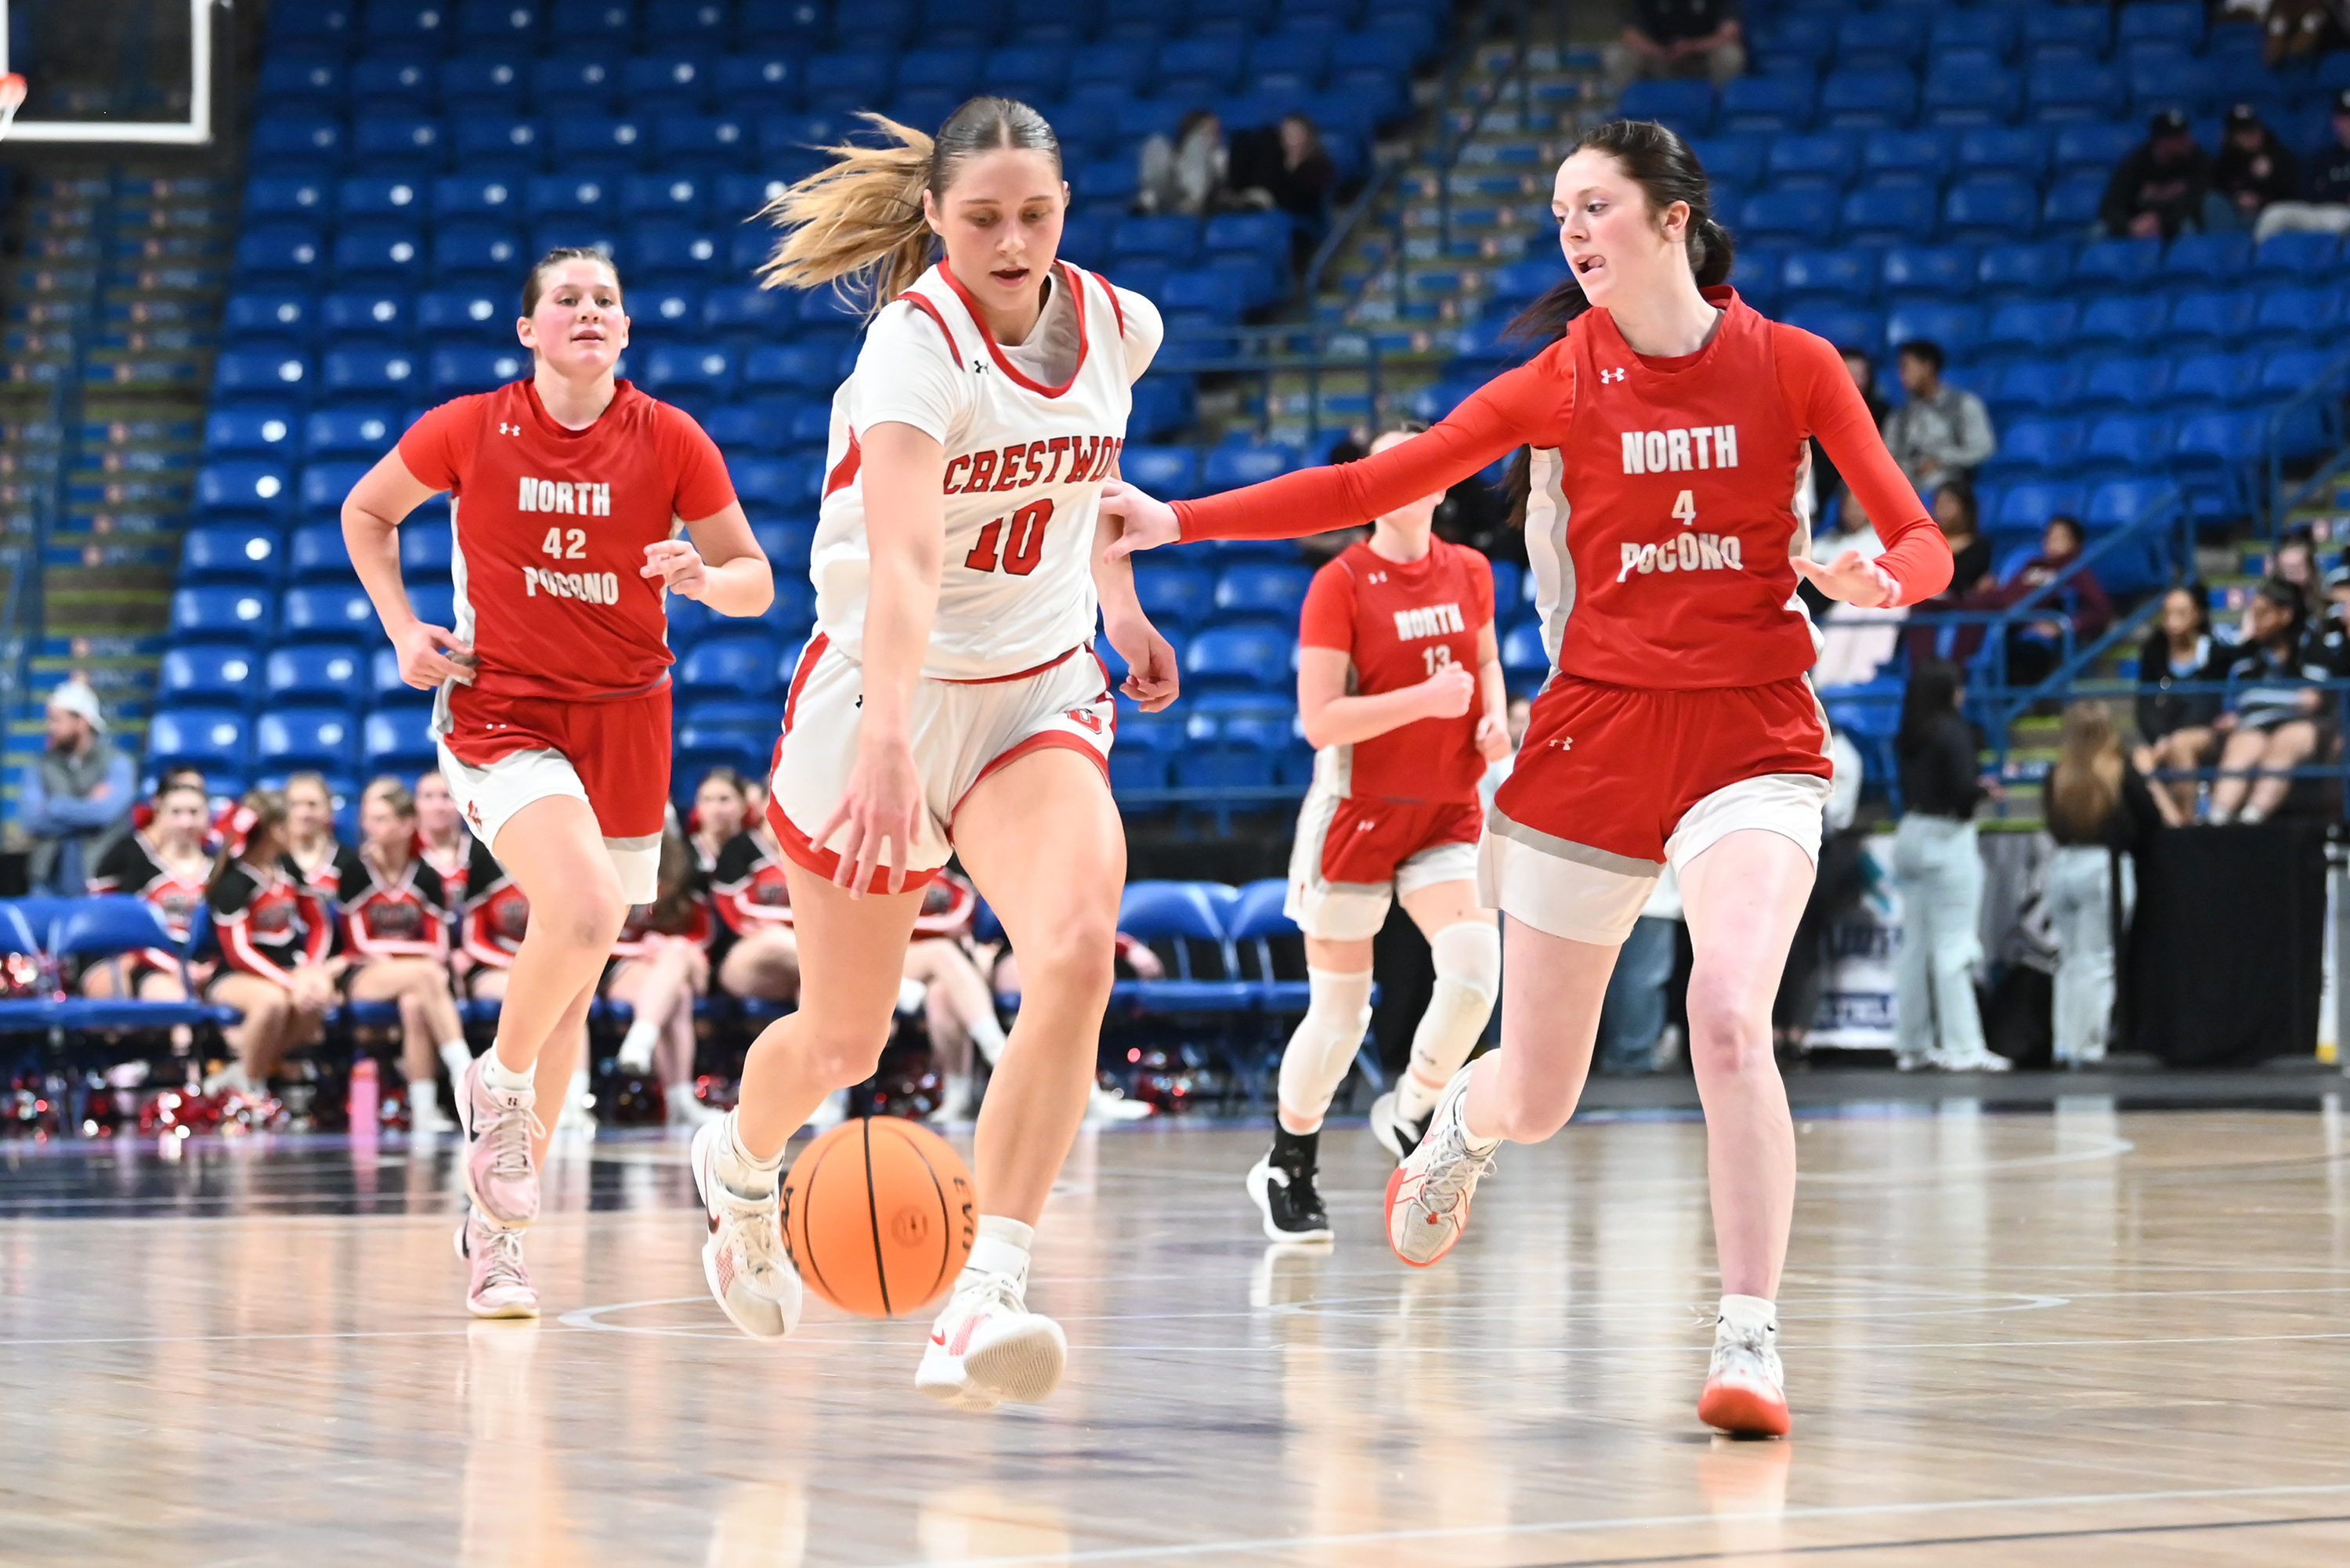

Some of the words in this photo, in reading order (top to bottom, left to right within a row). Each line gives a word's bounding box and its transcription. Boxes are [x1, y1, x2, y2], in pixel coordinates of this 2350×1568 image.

[1621, 425, 1738, 475] NORTH
[519, 476, 610, 517] NORTH
[1671, 490, 1697, 526] 4
[541, 526, 587, 559] 42
[964, 498, 1055, 576] 10
[1616, 532, 1744, 583] POCONO
[522, 565, 620, 605] POCONO
[1394, 602, 1466, 641] NORTH
[1422, 644, 1452, 677] 13
